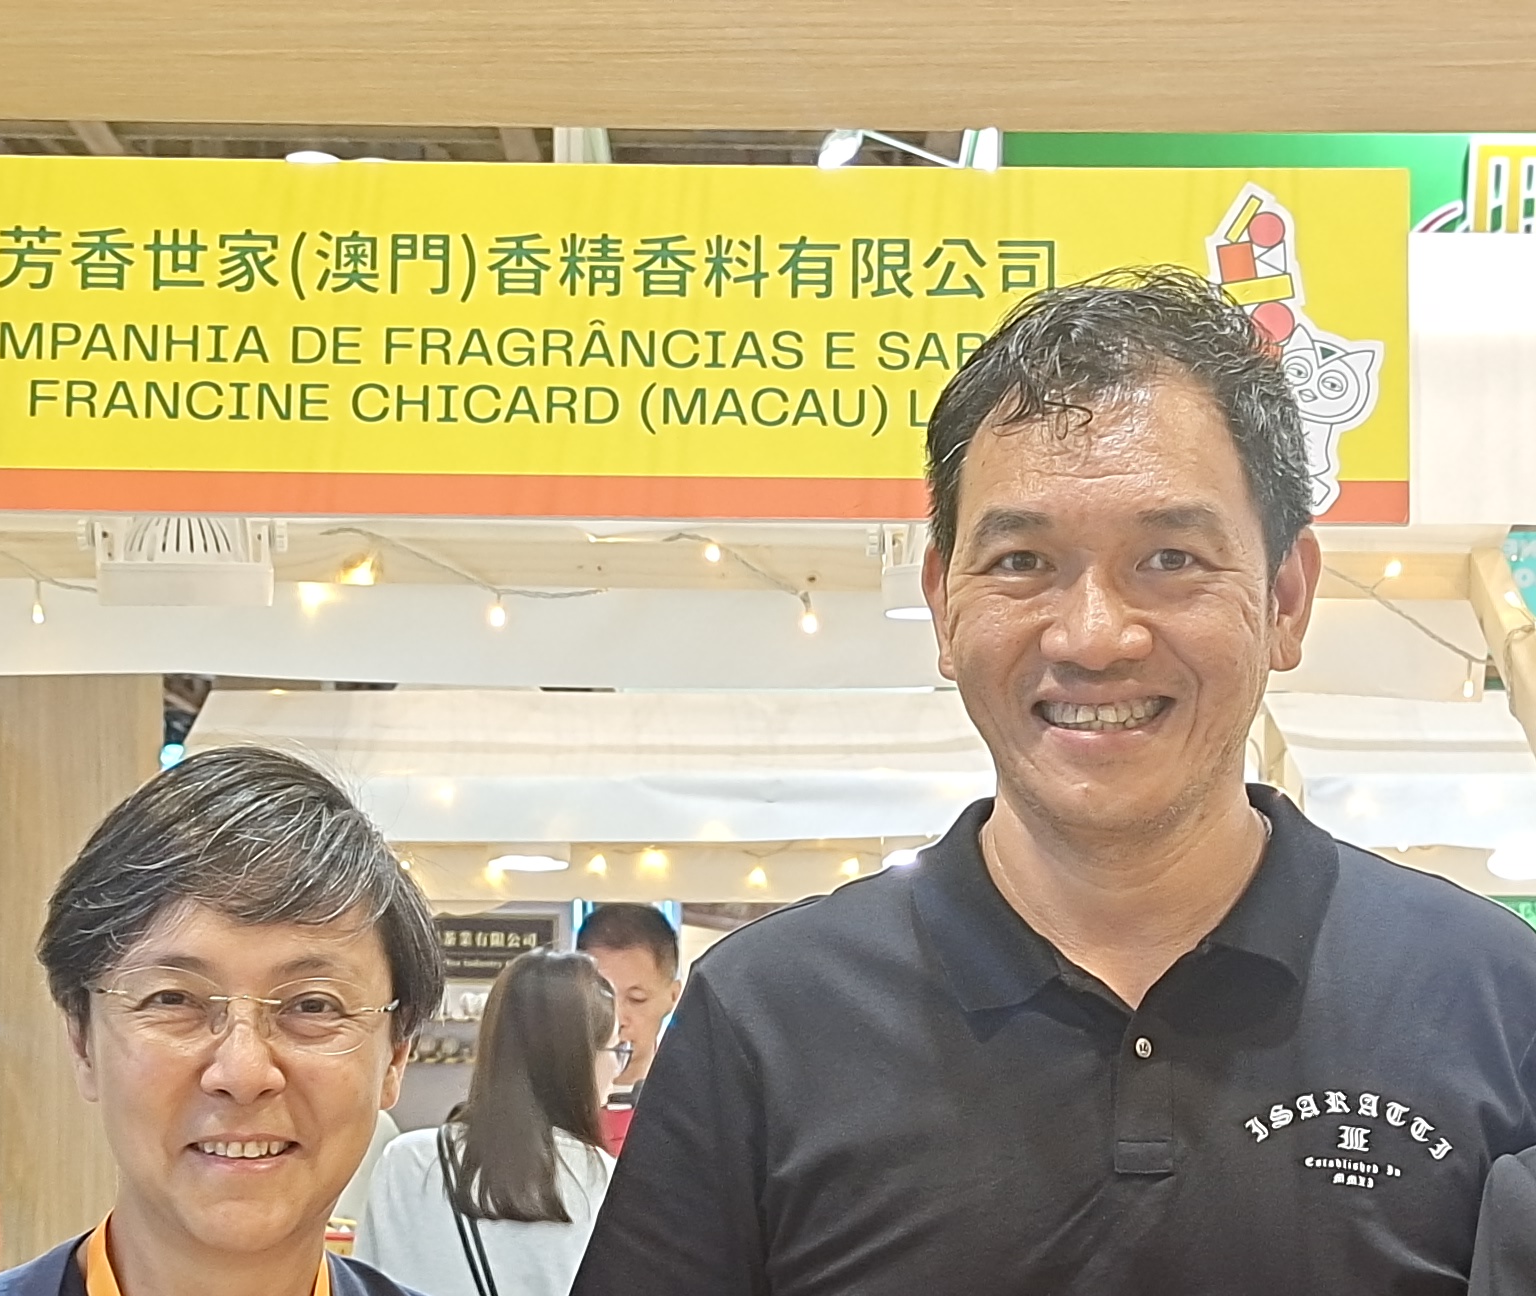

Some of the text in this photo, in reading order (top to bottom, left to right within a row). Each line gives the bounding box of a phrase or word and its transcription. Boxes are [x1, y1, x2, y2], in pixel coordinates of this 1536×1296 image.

[292, 326, 362, 365] DE
[383, 318, 803, 370] FRAGRÂNCIAS
[827, 331, 855, 369] E
[29, 379, 330, 421] FRANCINE
[351, 383, 620, 426] CHICARD
[641, 382, 889, 437] (MACAU)
